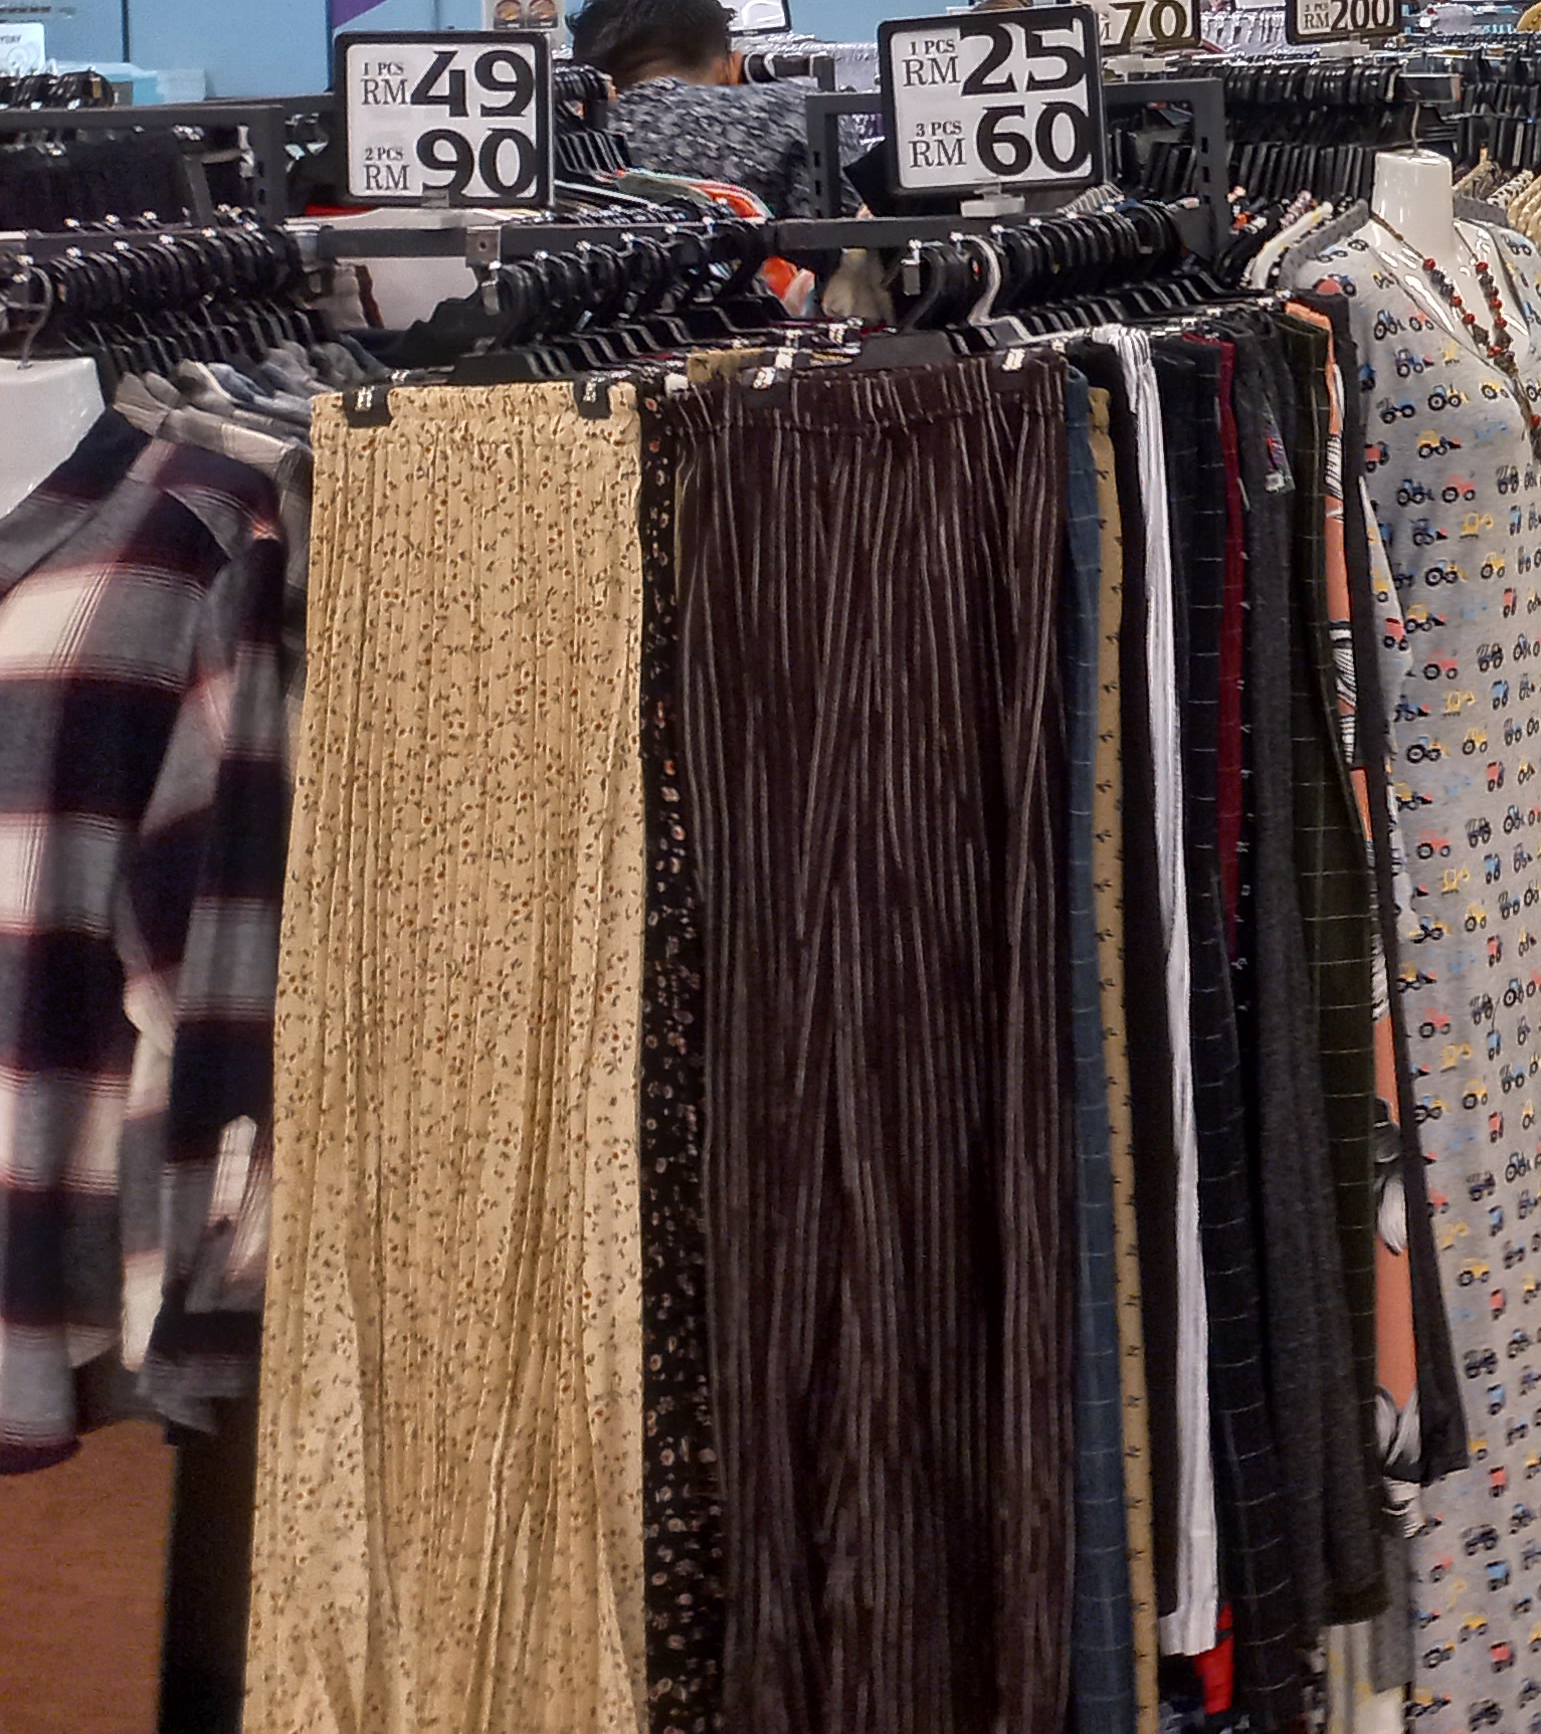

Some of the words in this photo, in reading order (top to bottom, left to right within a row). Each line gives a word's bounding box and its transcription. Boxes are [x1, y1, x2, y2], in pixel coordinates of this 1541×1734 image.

[1108, 0, 1188, 45] 70
[1304, 12, 1330, 30] RM
[902, 56, 961, 87] RM
[960, 22, 1087, 96] 25
[911, 41, 917, 55] 1
[925, 39, 956, 54] PCS
[361, 79, 410, 105] RM
[410, 49, 534, 118] 49
[363, 62, 369, 76] 1
[377, 62, 404, 76] PCS
[908, 138, 967, 168] RM
[976, 101, 1090, 176] 60
[916, 123, 925, 137] 3
[931, 121, 962, 135] PCS
[363, 164, 410, 191] RM
[416, 128, 537, 198] 90
[365, 147, 374, 161] 2
[377, 147, 404, 161] PCS
